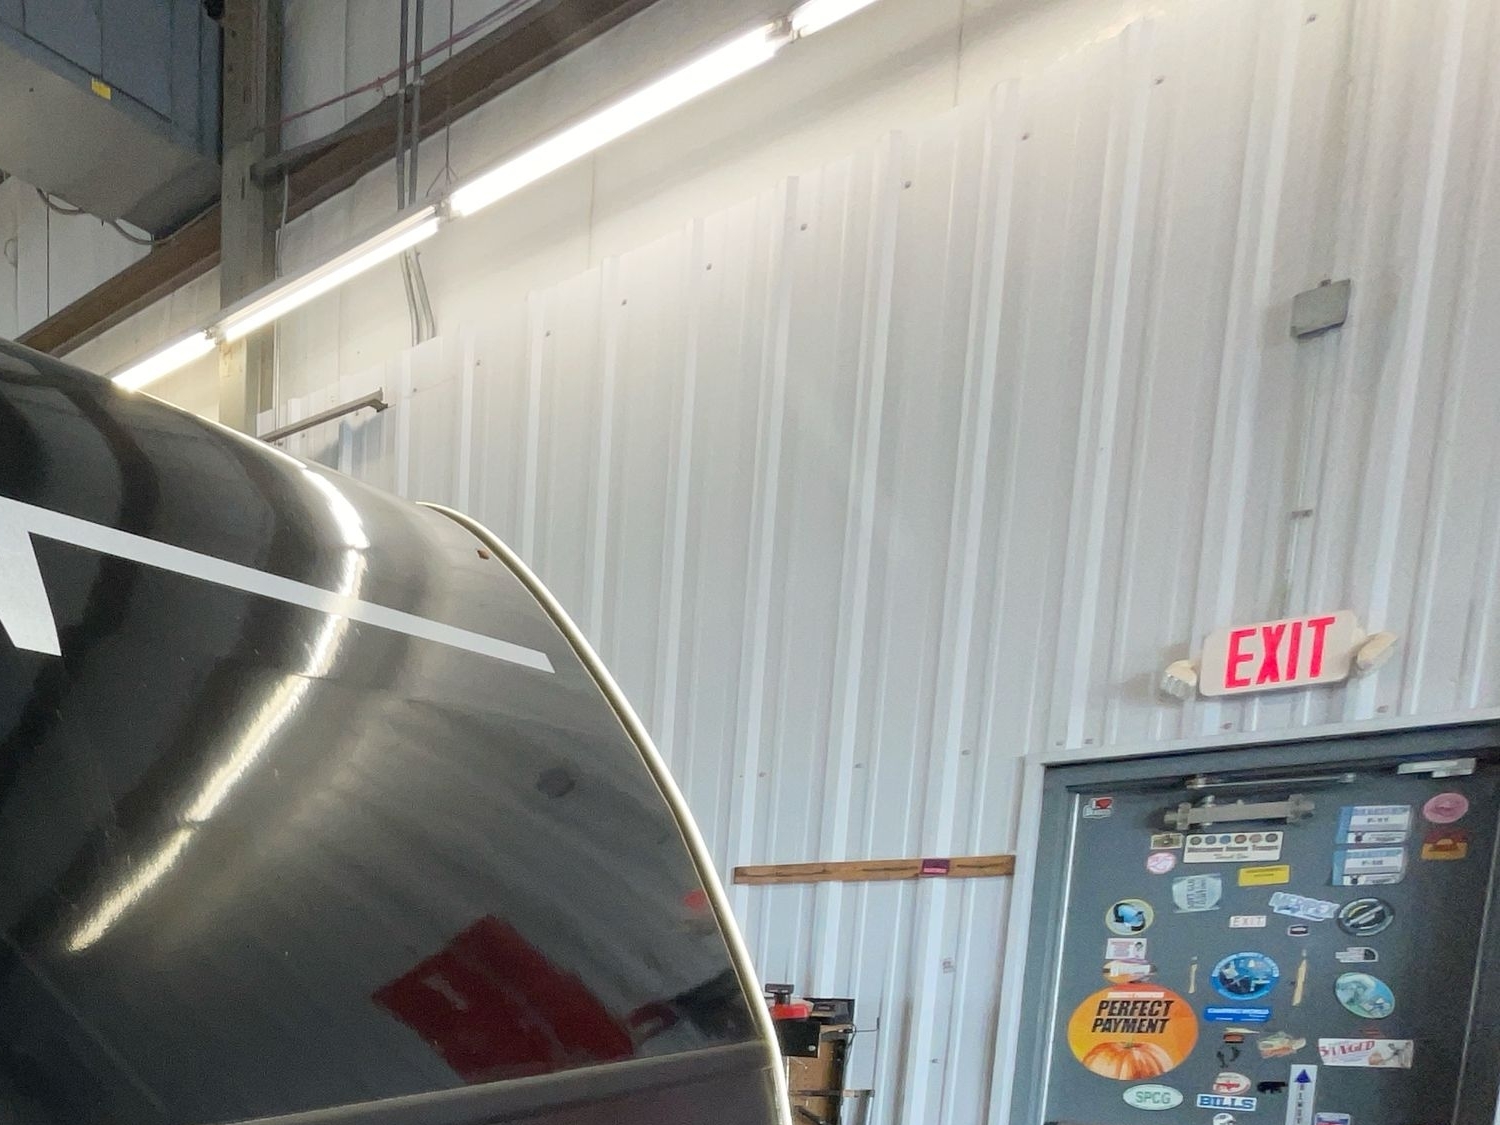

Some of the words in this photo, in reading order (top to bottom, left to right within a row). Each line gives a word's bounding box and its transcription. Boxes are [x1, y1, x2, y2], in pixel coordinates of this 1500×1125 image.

[1224, 616, 1336, 689] EXIT
[1096, 1000, 1174, 1017] PERFECT
[1091, 1018, 1170, 1034] PAYMENT
[1135, 1091, 1171, 1105] SPCG
[1200, 1096, 1254, 1109] BILLS
